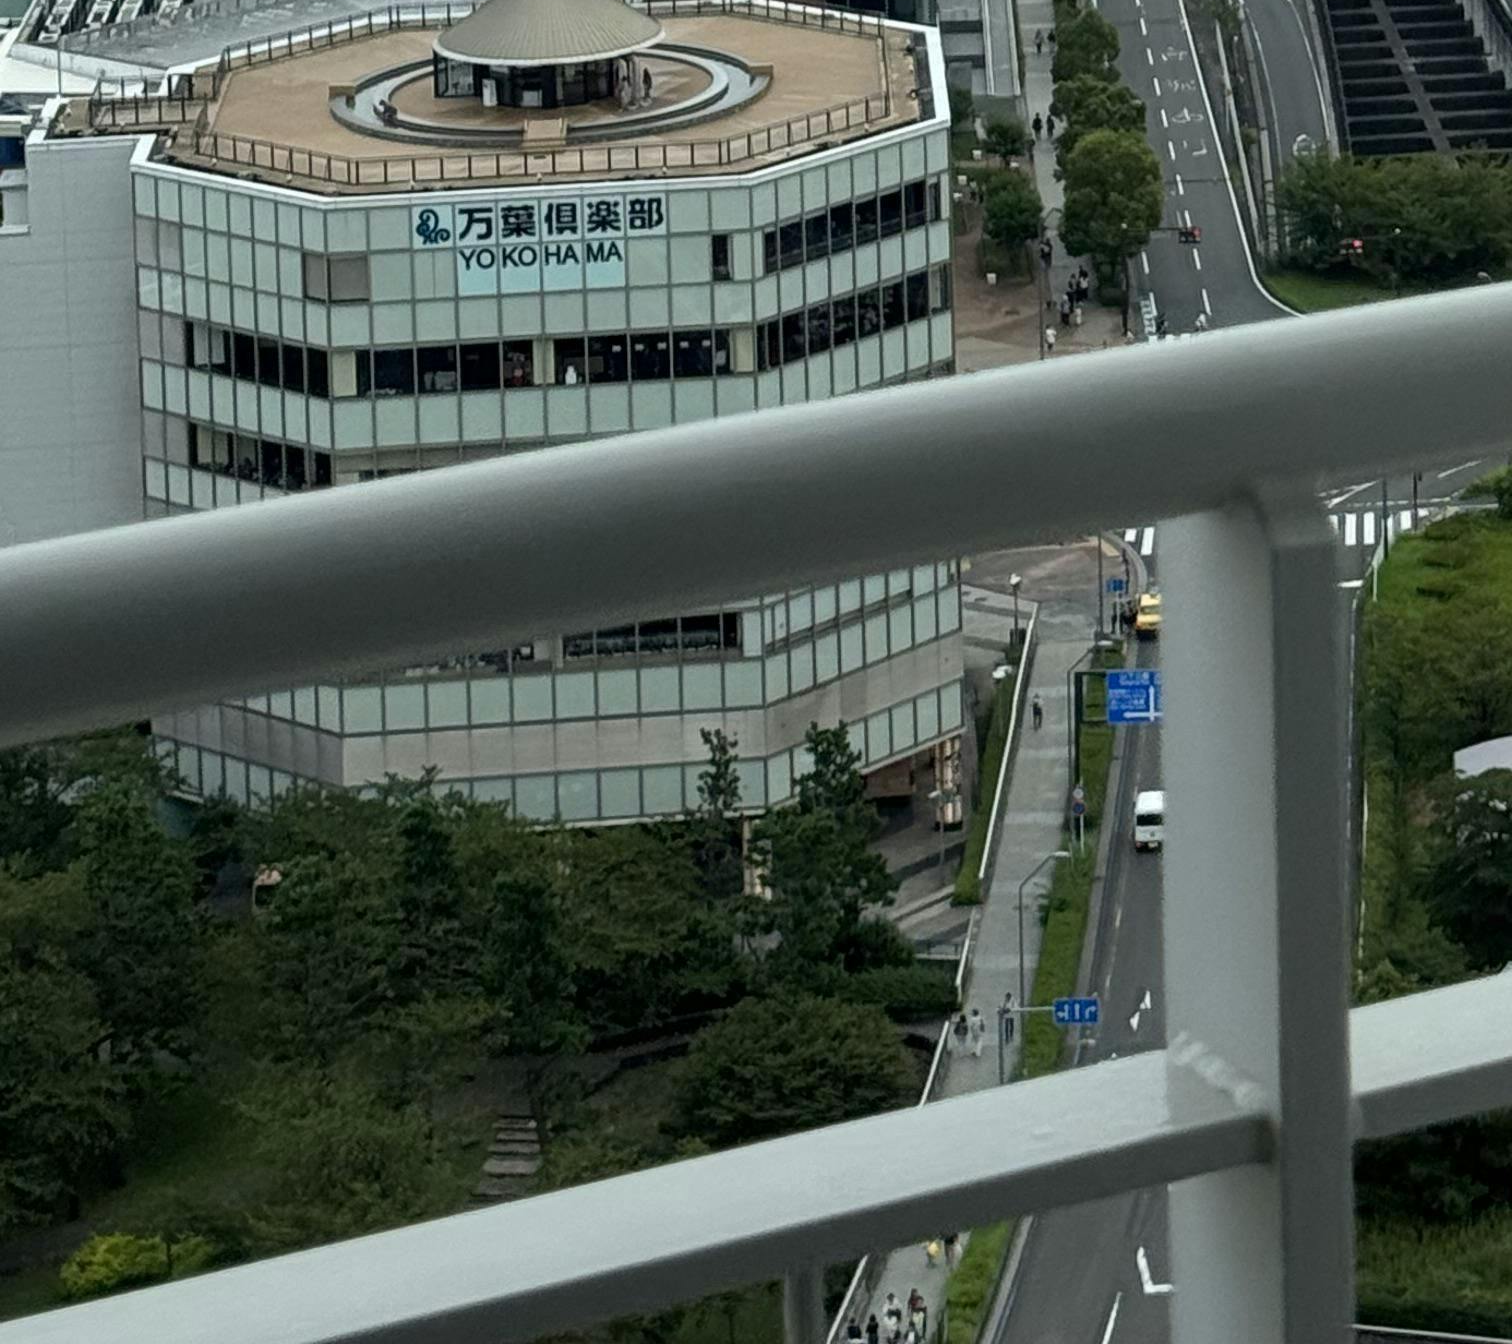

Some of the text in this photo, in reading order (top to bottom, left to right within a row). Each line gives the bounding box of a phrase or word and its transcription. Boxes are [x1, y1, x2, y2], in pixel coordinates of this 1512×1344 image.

[457, 197, 664, 242] 万葉倶楽部
[459, 241, 624, 271] YOKOHAMA
